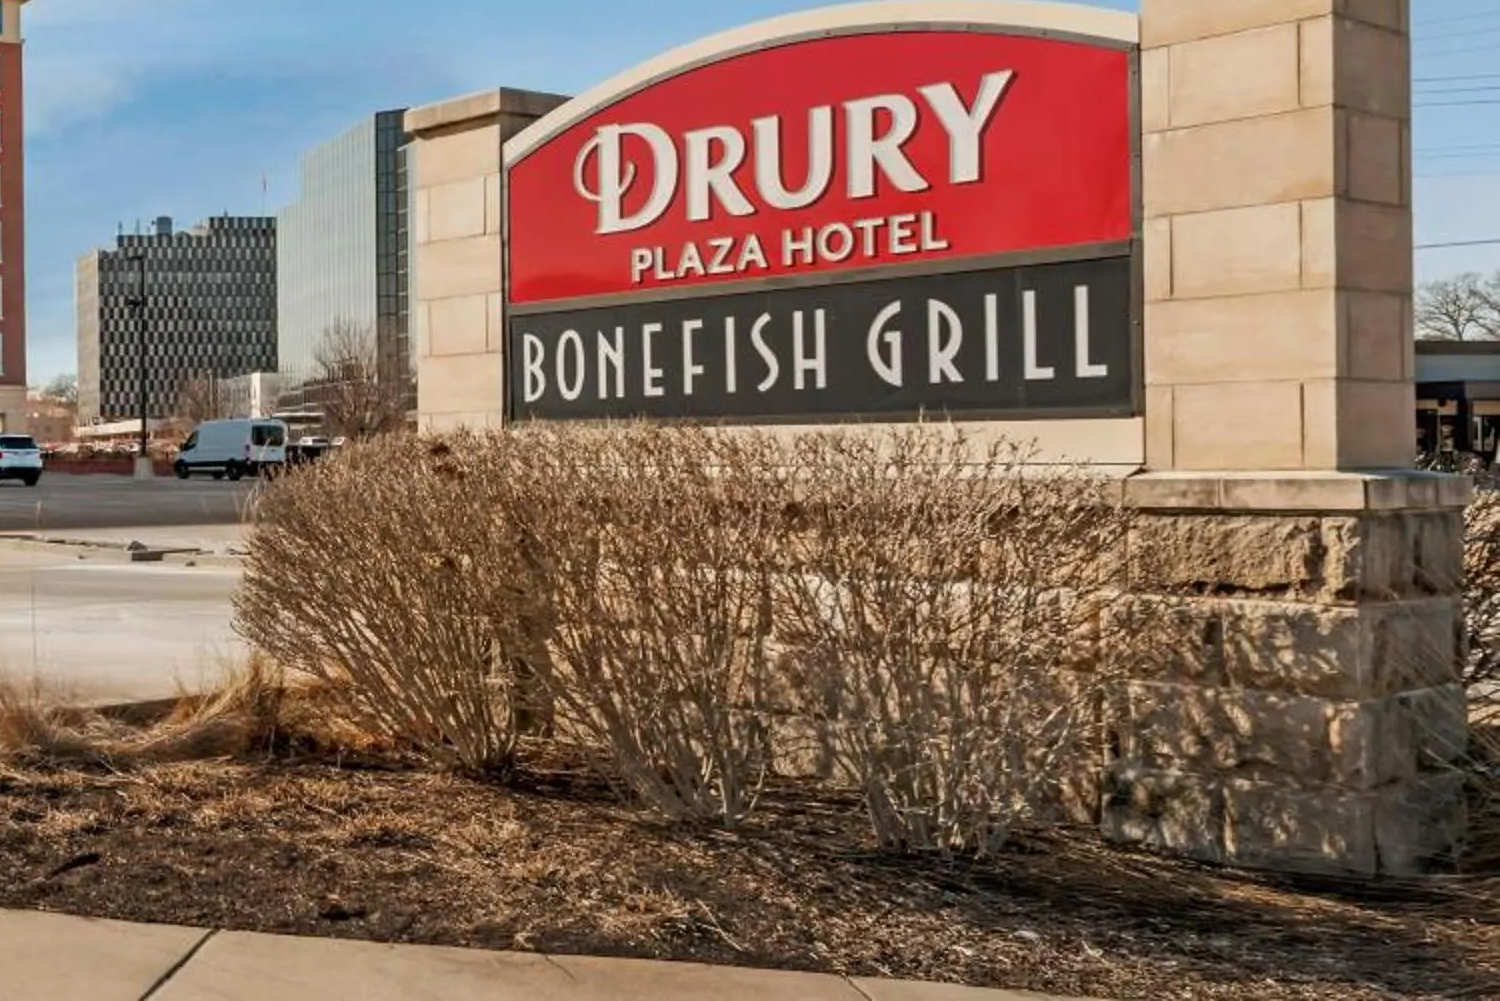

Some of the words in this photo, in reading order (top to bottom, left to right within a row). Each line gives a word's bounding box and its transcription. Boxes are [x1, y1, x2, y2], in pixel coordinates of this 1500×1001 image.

[574, 69, 1013, 234] DRURY
[631, 237, 767, 282] PLAZA
[782, 211, 949, 266] HOTEL
[523, 309, 827, 403] BONEFISH
[867, 285, 1108, 387] GRILL
